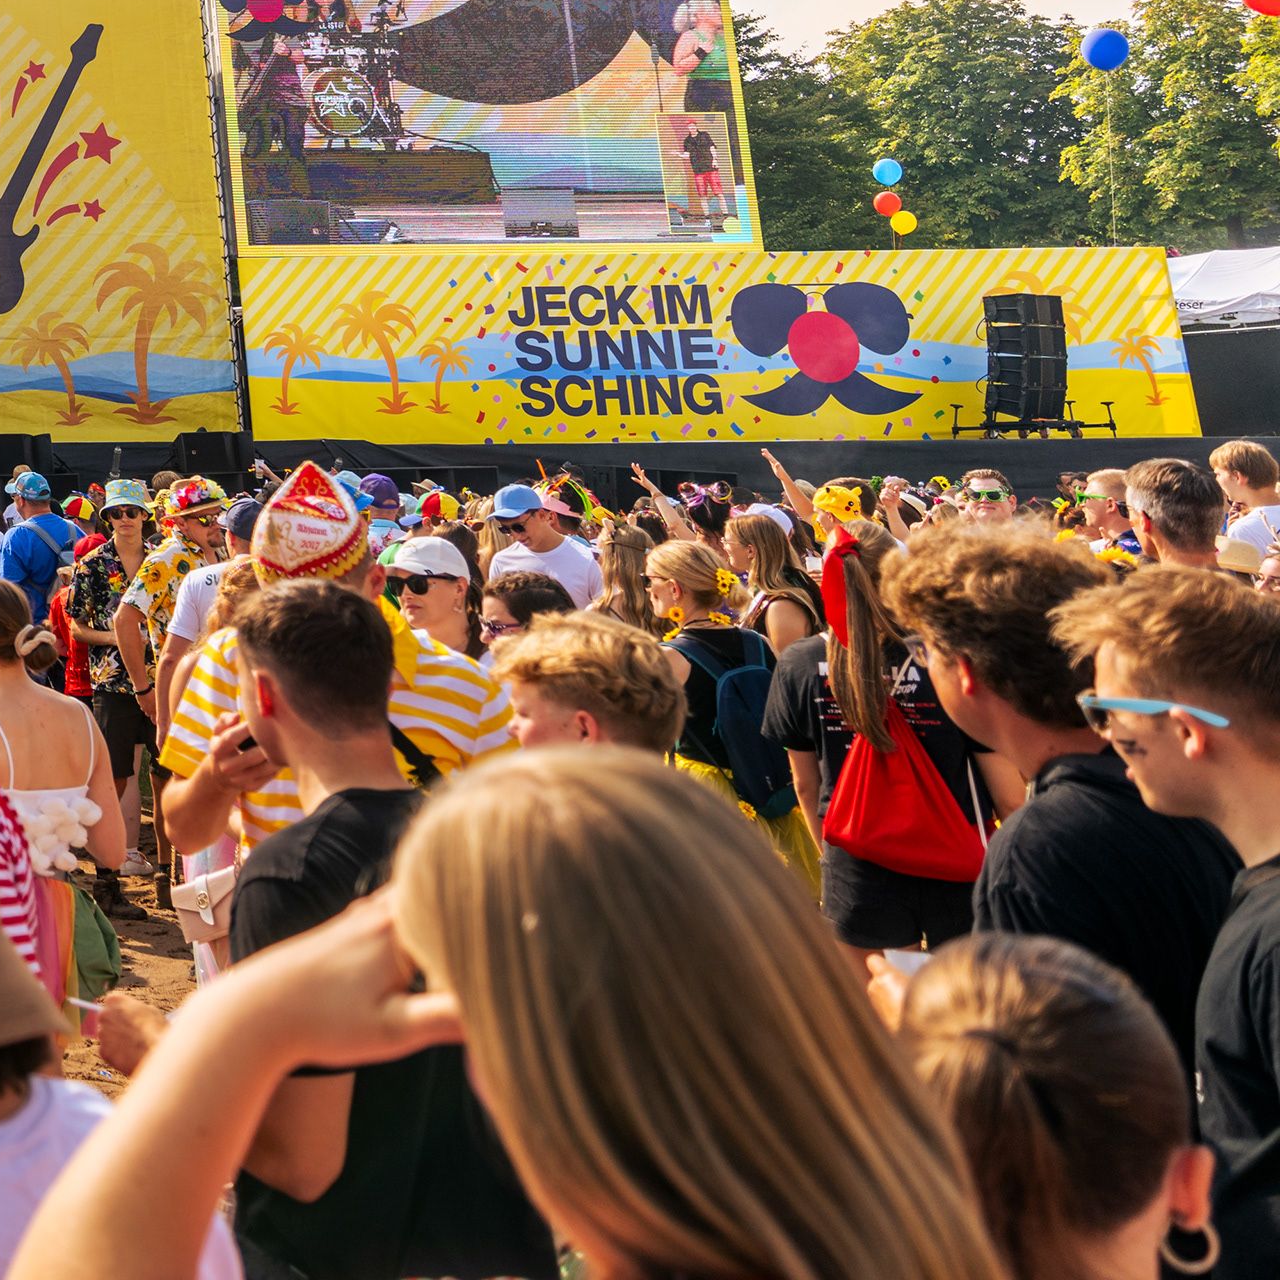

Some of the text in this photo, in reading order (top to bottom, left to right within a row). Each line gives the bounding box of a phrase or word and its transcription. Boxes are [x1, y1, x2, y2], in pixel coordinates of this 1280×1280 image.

[508, 285, 712, 327] JECK IM
[515, 329, 718, 373] SUNNE
[521, 374, 723, 417] SCHING
